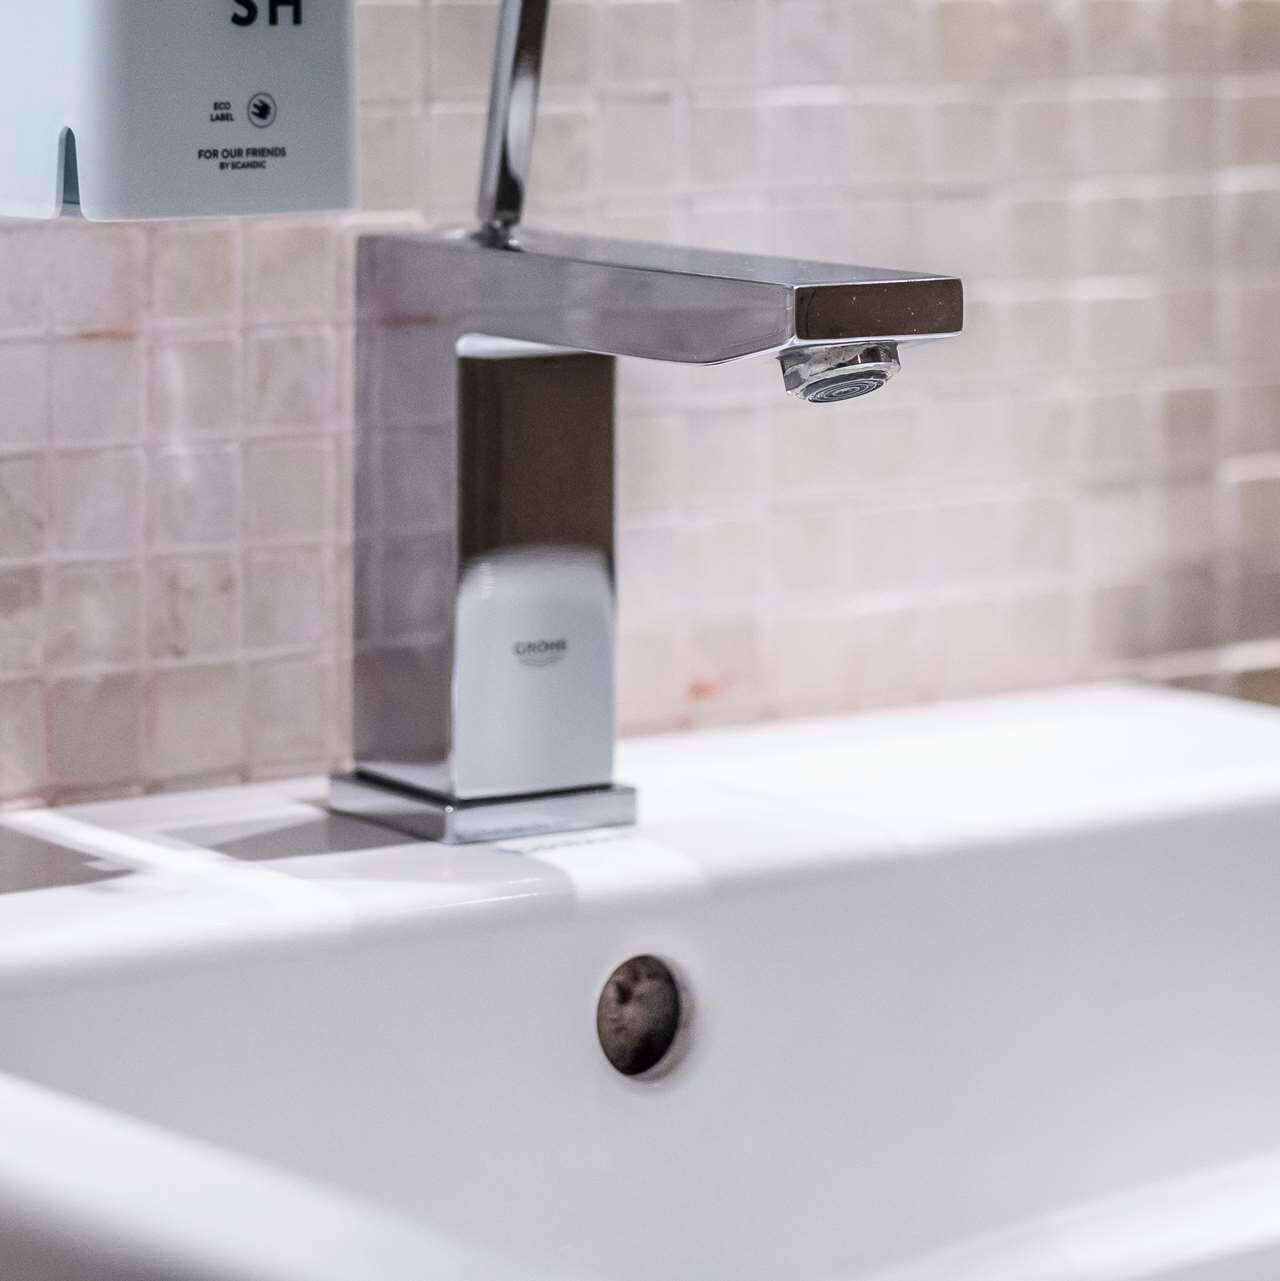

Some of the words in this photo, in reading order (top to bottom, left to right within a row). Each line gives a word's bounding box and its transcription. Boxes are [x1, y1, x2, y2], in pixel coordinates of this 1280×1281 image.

[213, 102, 232, 111] ECO
[210, 113, 234, 121] LABEL
[198, 149, 219, 160] FOR
[221, 148, 243, 159] OUR
[245, 147, 287, 157] FRIENDS
[219, 161, 230, 170] BY
[231, 160, 266, 170] SCANDIC
[514, 639, 567, 655] GROHE
